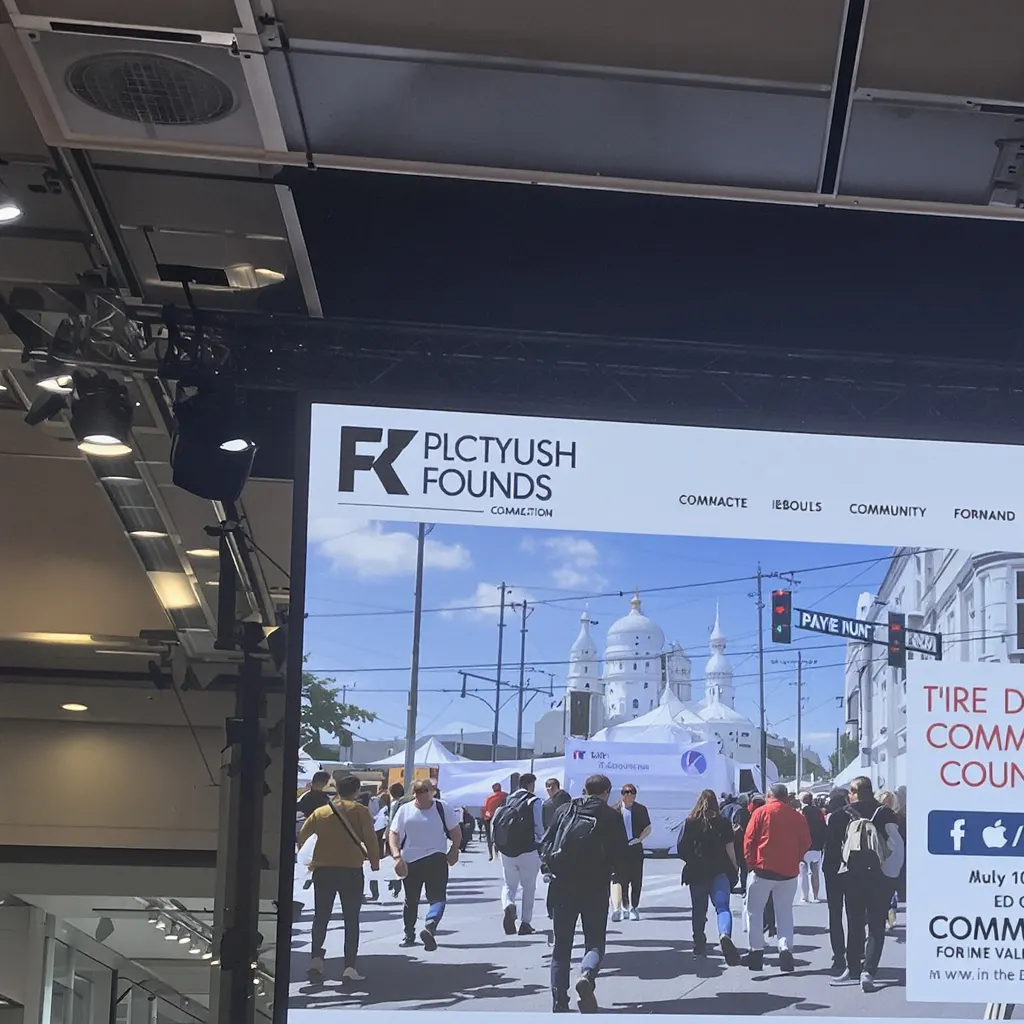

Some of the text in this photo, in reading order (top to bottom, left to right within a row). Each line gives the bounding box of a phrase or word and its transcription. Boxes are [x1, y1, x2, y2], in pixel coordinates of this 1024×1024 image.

[424, 432, 576, 468] PLCTYUSH
[423, 467, 552, 501] FOUNDS
[849, 503, 927, 518] COMMUNITY
[953, 508, 1016, 522] FORNAND
[994, 894, 1014, 908] ED
[936, 945, 964, 958] FOR
[994, 969, 1015, 982] the
